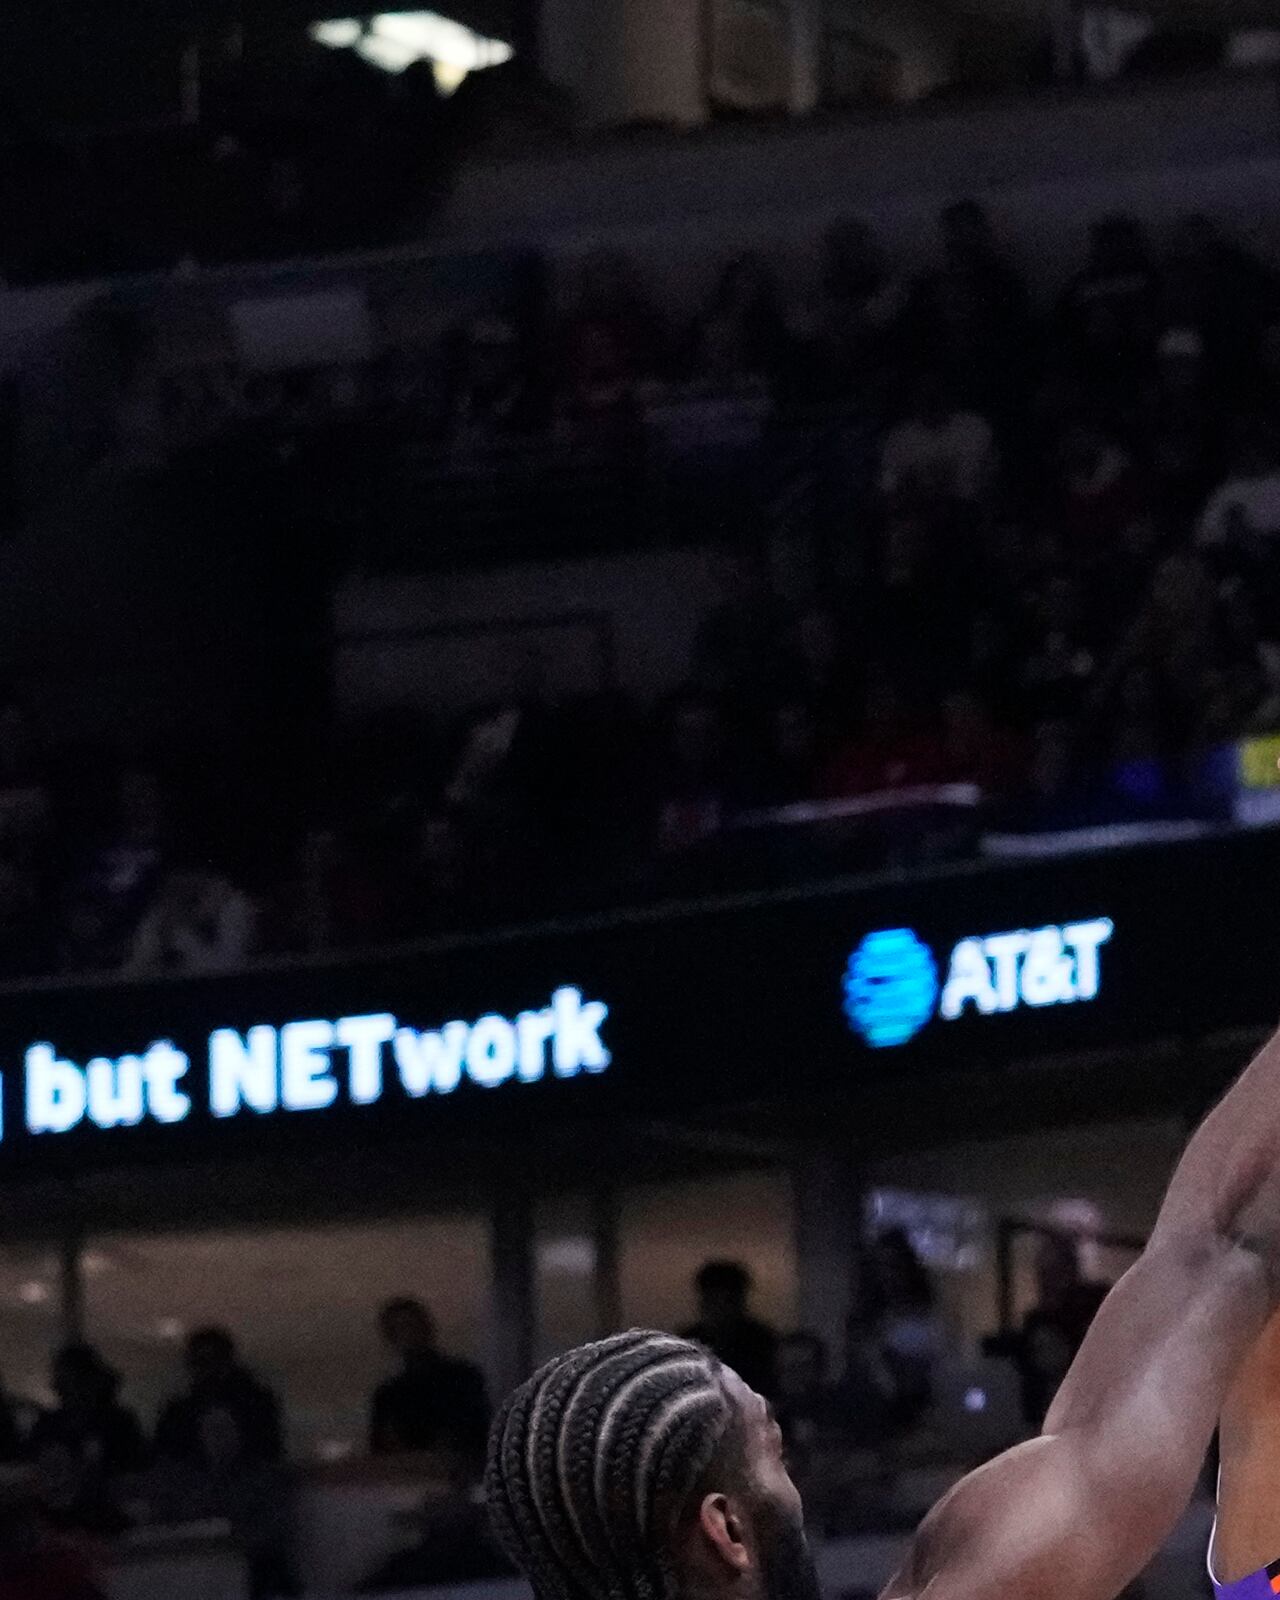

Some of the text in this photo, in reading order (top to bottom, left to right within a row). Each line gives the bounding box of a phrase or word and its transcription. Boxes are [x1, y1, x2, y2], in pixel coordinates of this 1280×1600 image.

[940, 916, 1114, 1020] AT&T
[24, 1040, 190, 1134] but
[208, 984, 611, 1118] NETwork
